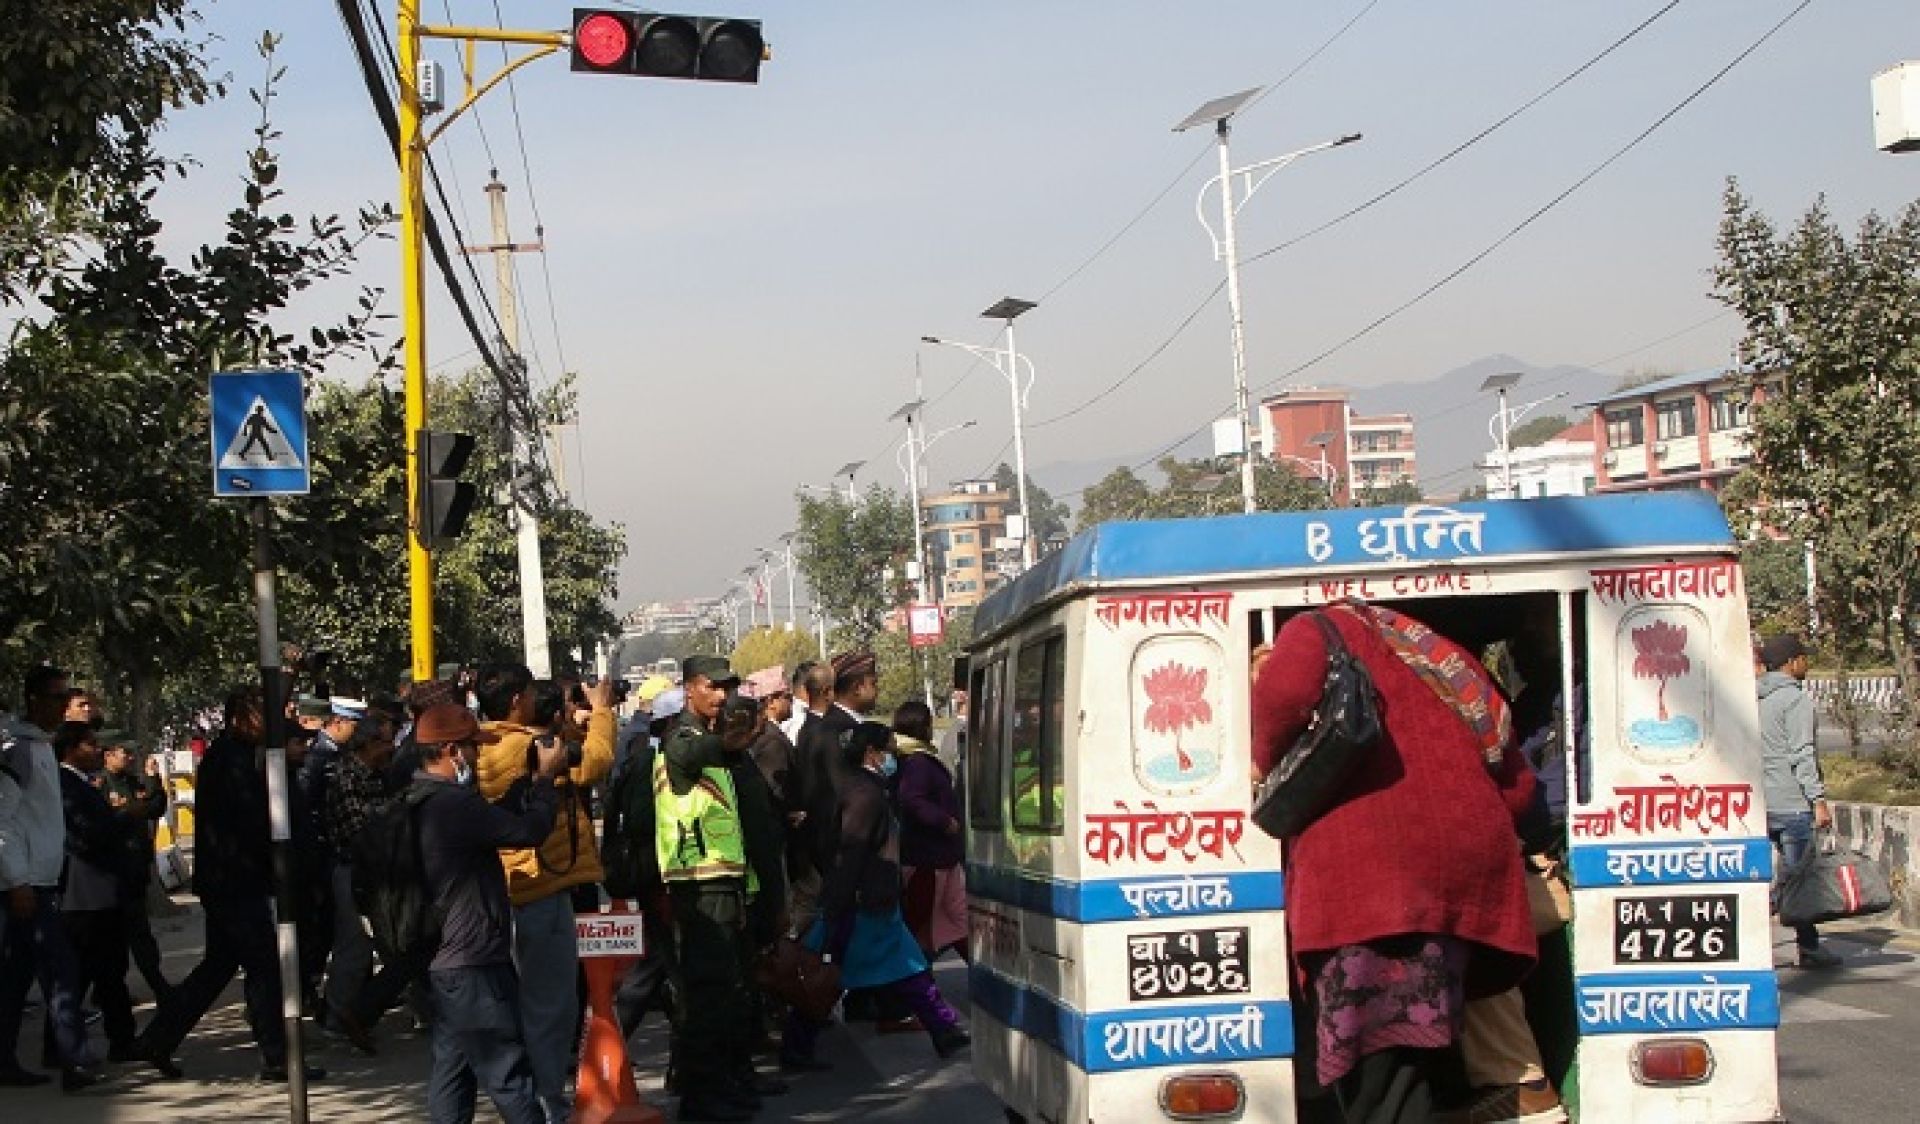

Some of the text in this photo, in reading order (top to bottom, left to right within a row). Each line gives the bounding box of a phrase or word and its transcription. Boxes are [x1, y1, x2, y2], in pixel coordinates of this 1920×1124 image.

[1306, 520, 1333, 562] B
[1085, 800, 1245, 866] कोटेश्वर
[1620, 928, 1724, 961] 4726
[1132, 958, 1249, 996] ४७२६
[1104, 1005, 1265, 1062] थापाथली
